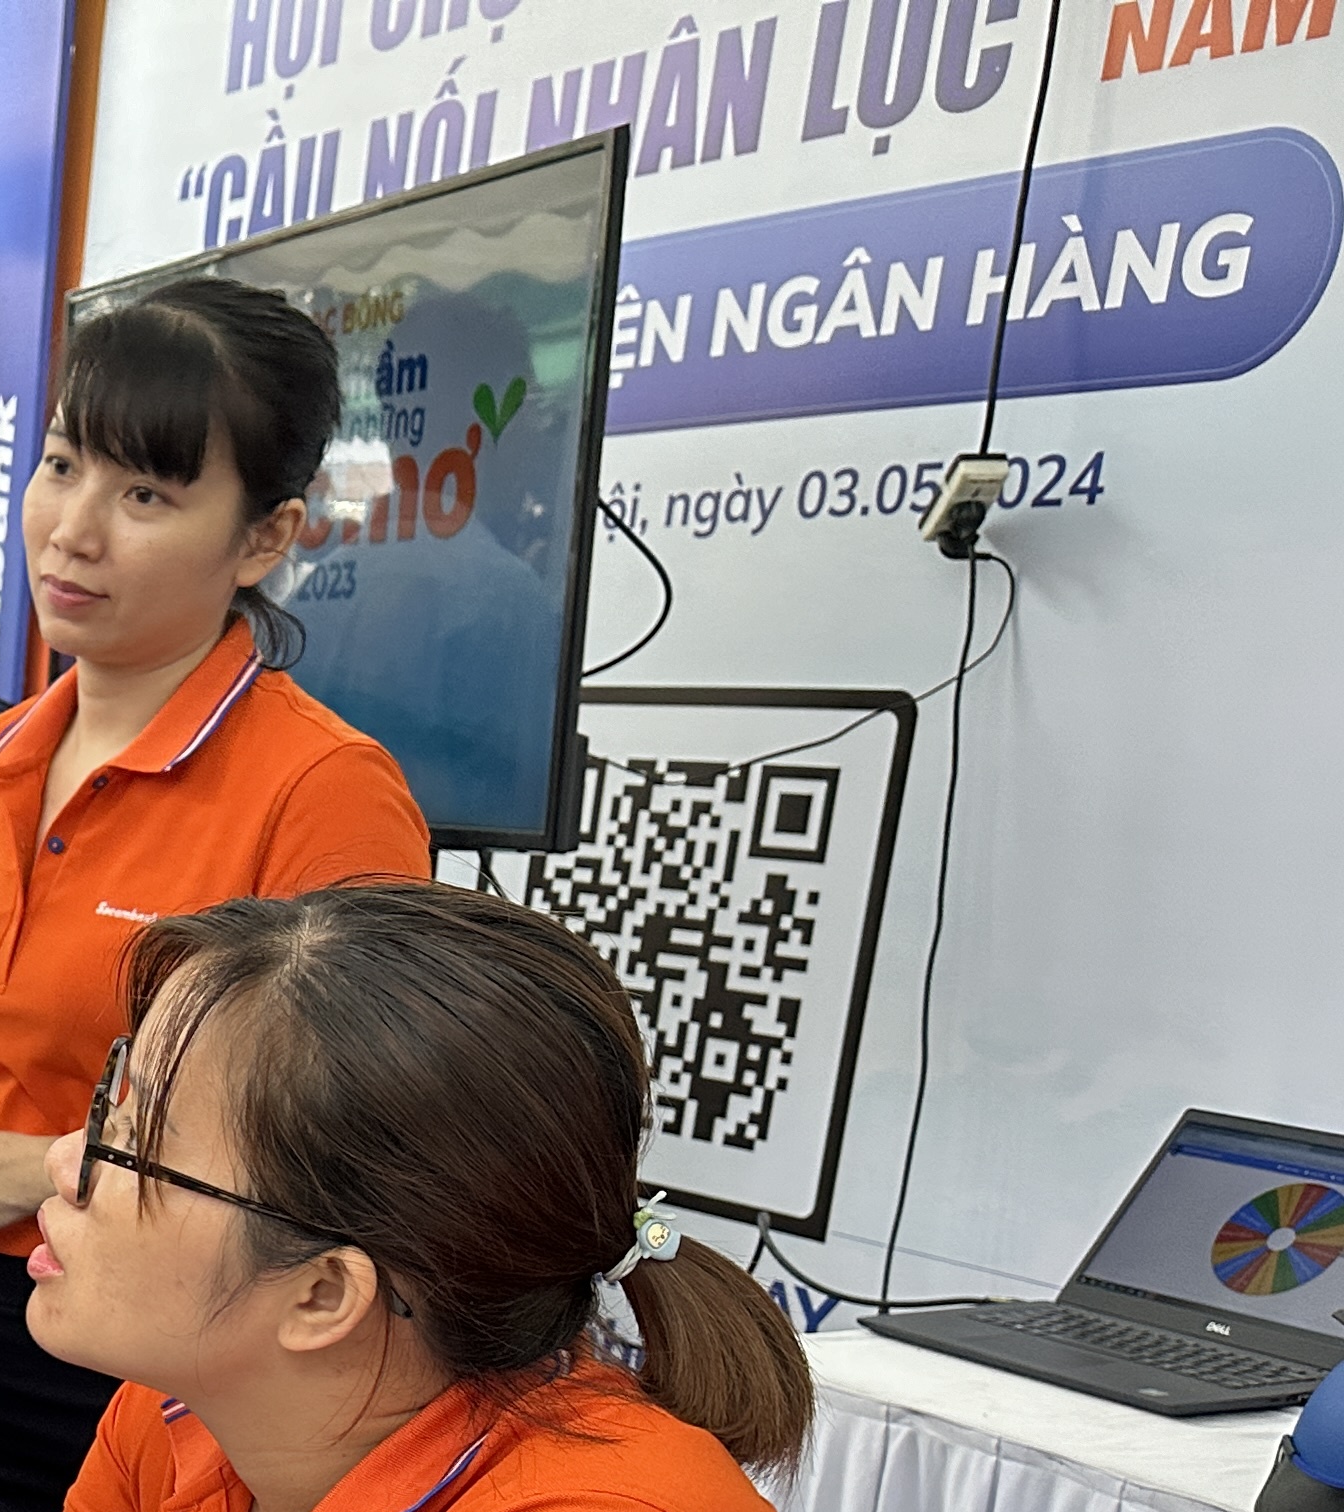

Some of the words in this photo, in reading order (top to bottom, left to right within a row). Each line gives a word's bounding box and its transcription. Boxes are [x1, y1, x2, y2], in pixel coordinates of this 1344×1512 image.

[524, 15, 779, 178] NHÂN
[709, 246, 944, 357] NGÂN
[965, 212, 1255, 326] HÀNG
[664, 474, 784, 537] ngày
